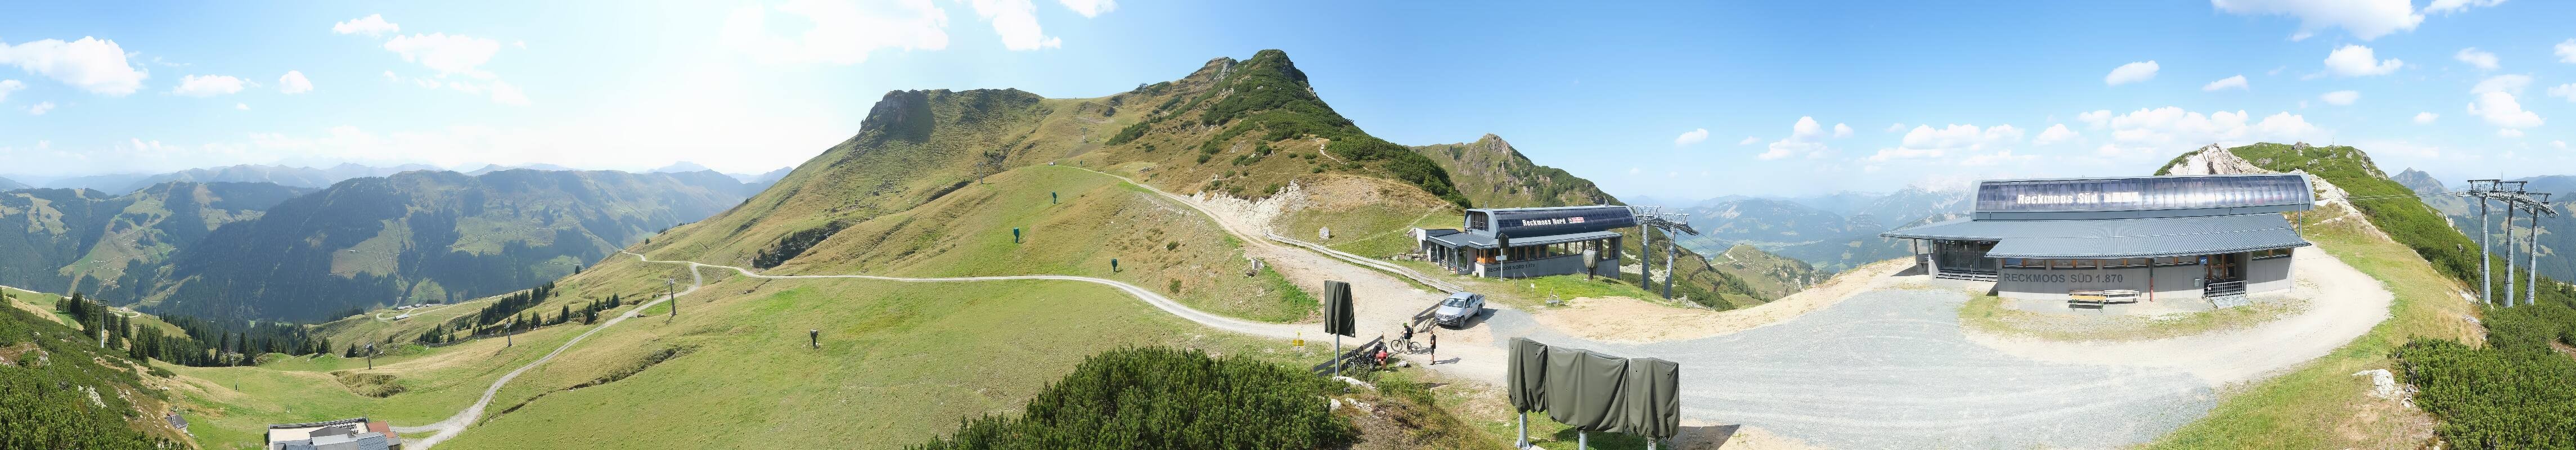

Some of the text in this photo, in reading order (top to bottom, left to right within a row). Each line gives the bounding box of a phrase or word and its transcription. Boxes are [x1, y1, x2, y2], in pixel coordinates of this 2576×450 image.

[2017, 193, 2073, 204] Reckmoos
[2077, 192, 2098, 203] Süd
[2004, 273, 2123, 283] RECKMOOS SÜD 1.870
